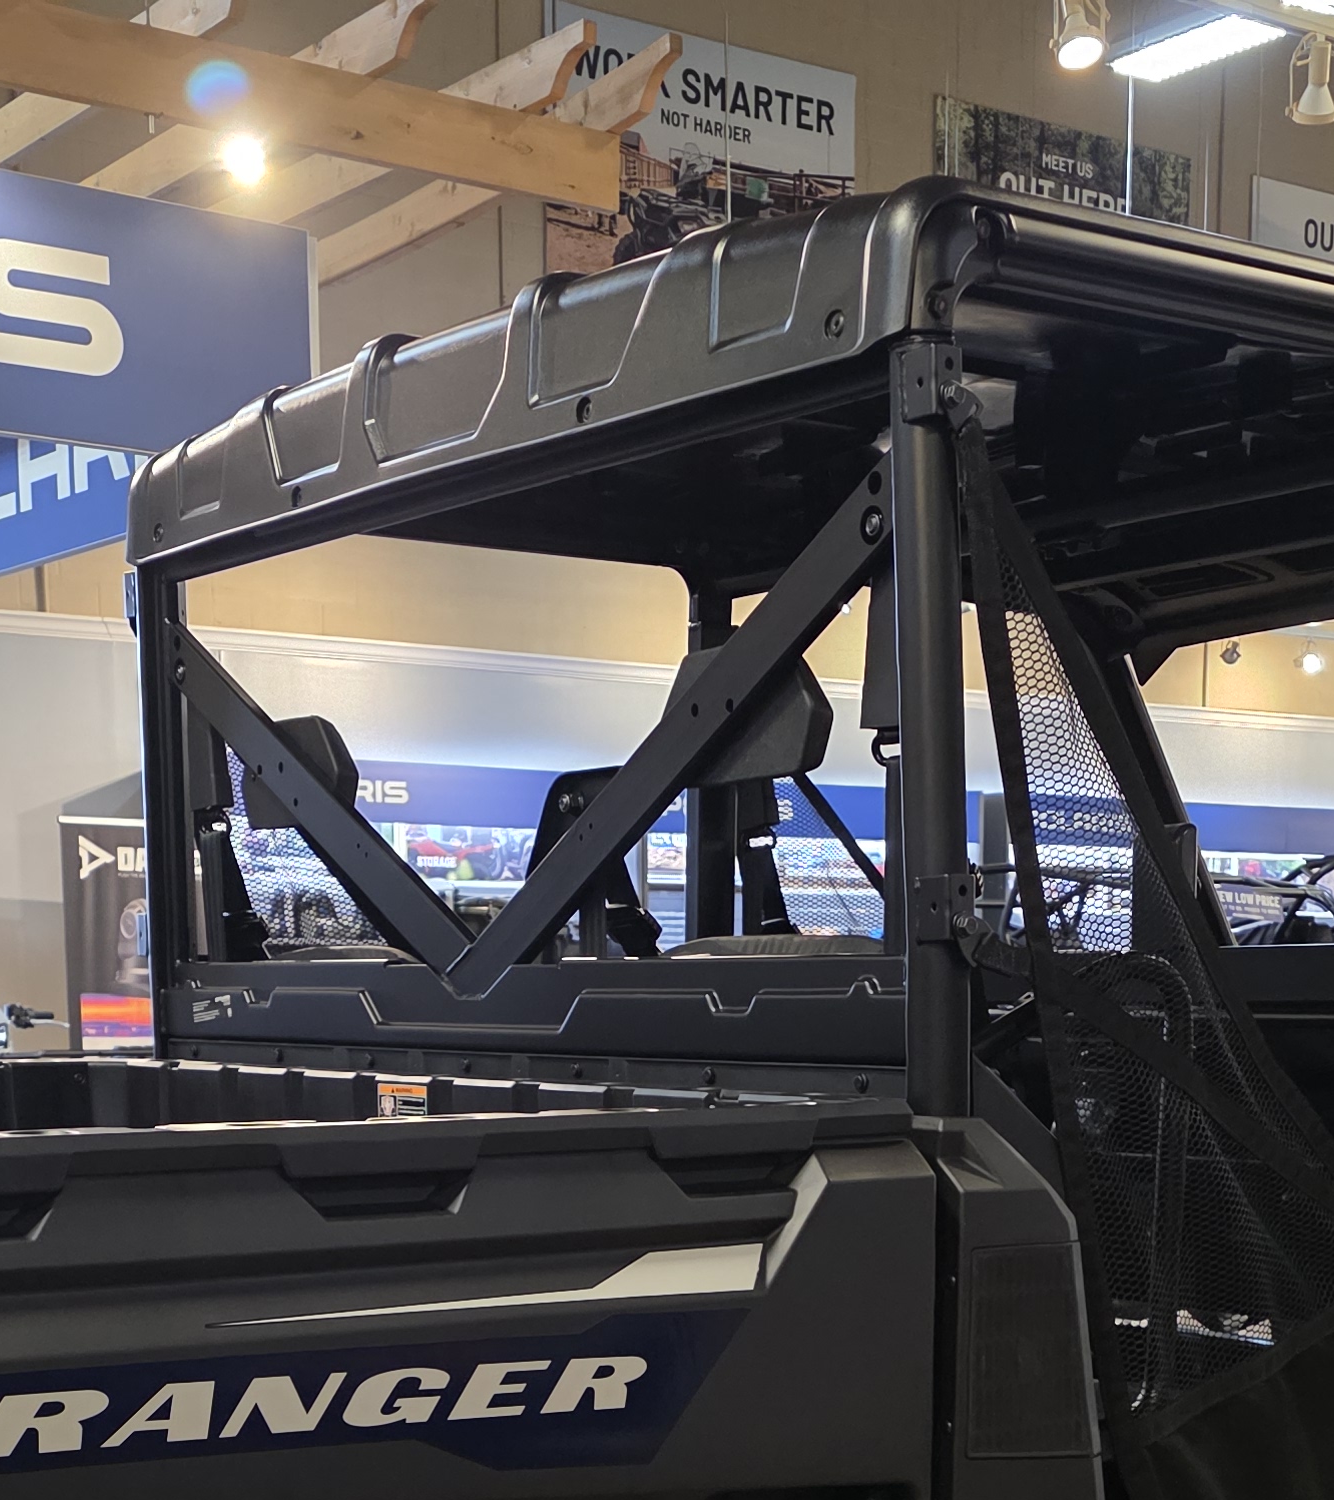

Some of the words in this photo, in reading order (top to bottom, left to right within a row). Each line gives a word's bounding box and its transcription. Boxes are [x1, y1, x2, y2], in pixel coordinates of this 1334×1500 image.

[681, 67, 836, 136] SMARTER
[660, 108, 691, 130] NOT
[693, 117, 752, 145] HARDER
[1042, 152, 1075, 174] MEET
[1077, 160, 1094, 179] US
[416, 855, 458, 869] STORAGE
[1234, 892, 1254, 905] LOW
[1255, 894, 1281, 908] PRICE
